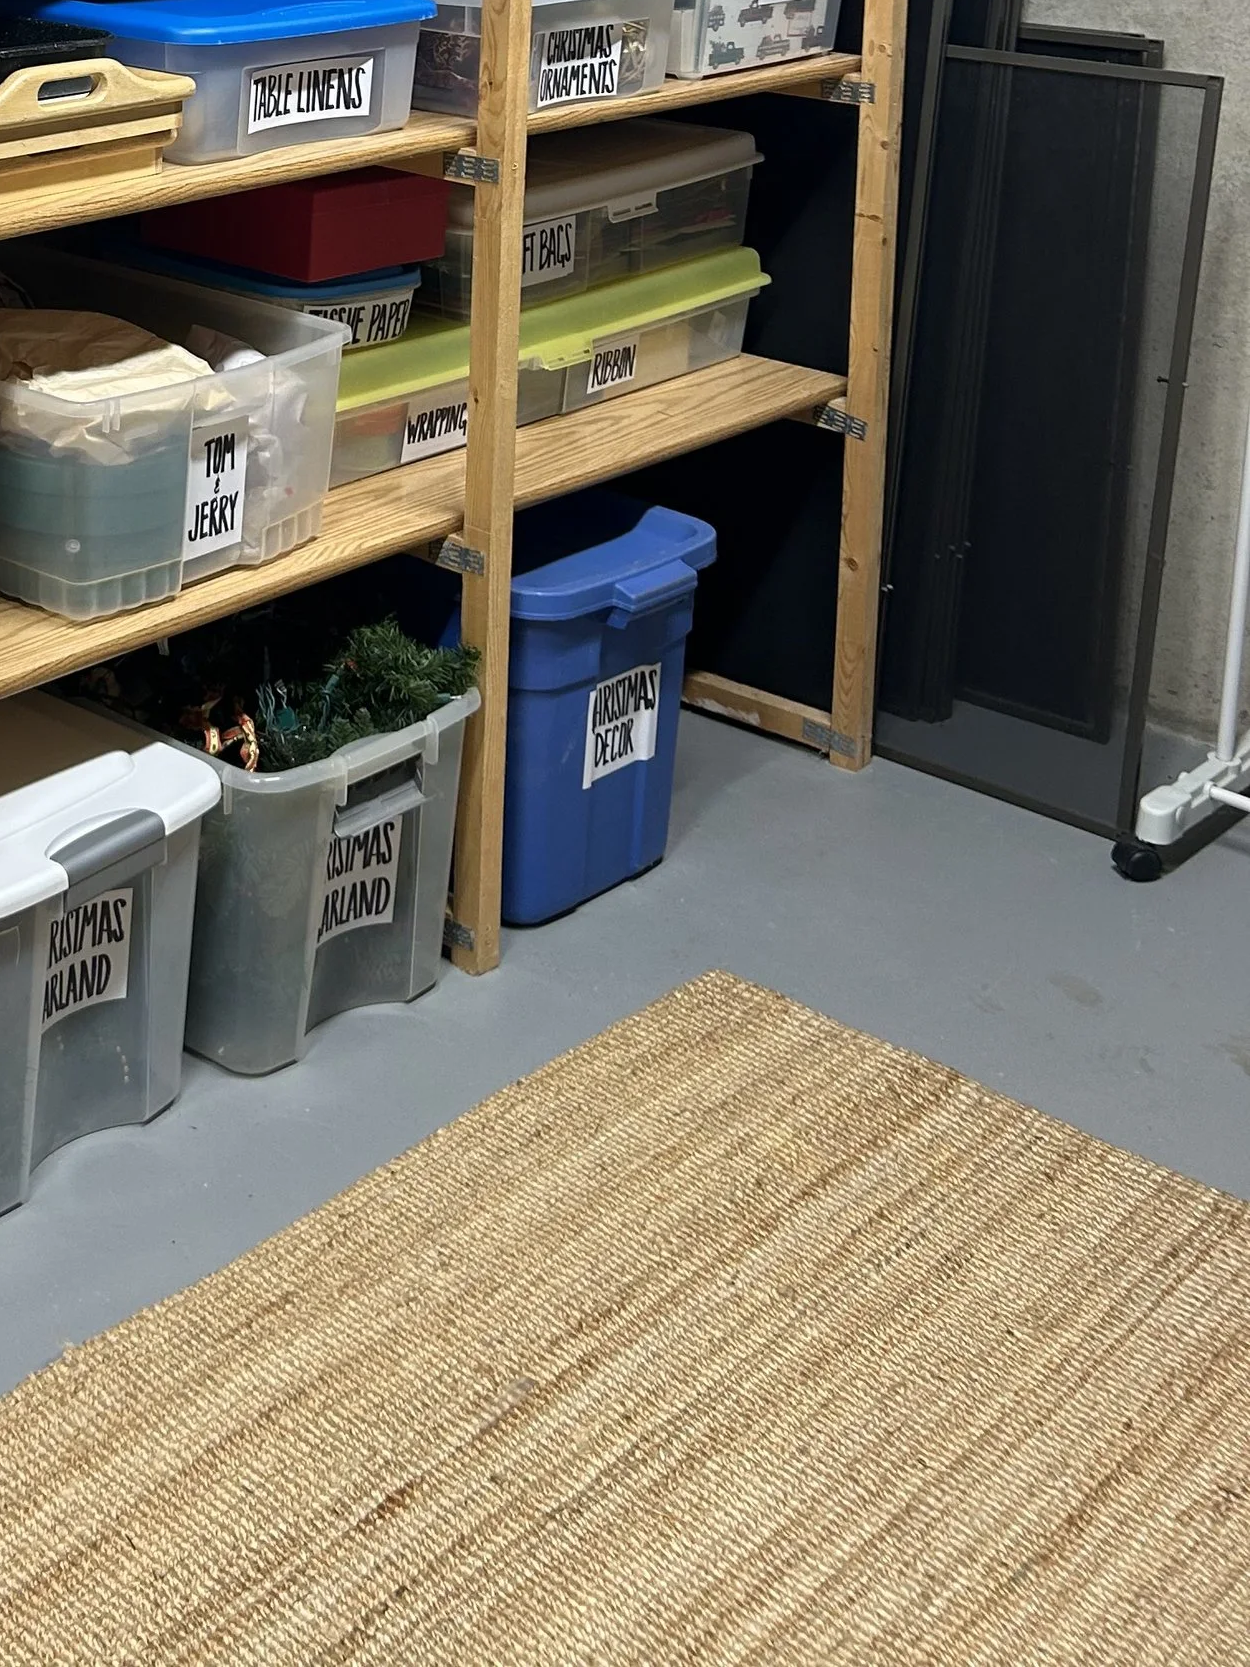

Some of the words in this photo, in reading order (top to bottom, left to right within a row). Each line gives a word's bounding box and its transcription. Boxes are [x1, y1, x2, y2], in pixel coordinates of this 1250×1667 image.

[547, 24, 614, 65] CHRISTMAS
[253, 71, 292, 123] TABLE
[296, 67, 366, 113] LINENS
[539, 59, 617, 102] ORNAMENTS
[523, 232, 536, 274] FT
[539, 223, 572, 271] BAGS
[366, 299, 410, 343] PAPER
[592, 343, 636, 389] RIBBON
[407, 402, 467, 444] WRAPPING
[204, 433, 235, 478] TOM
[188, 490, 239, 542] JERRY
[595, 718, 634, 768] DECOR
[318, 877, 390, 940] ARLAND
[48, 898, 127, 970] RISTMAS
[42, 953, 111, 1024] ARLAND
